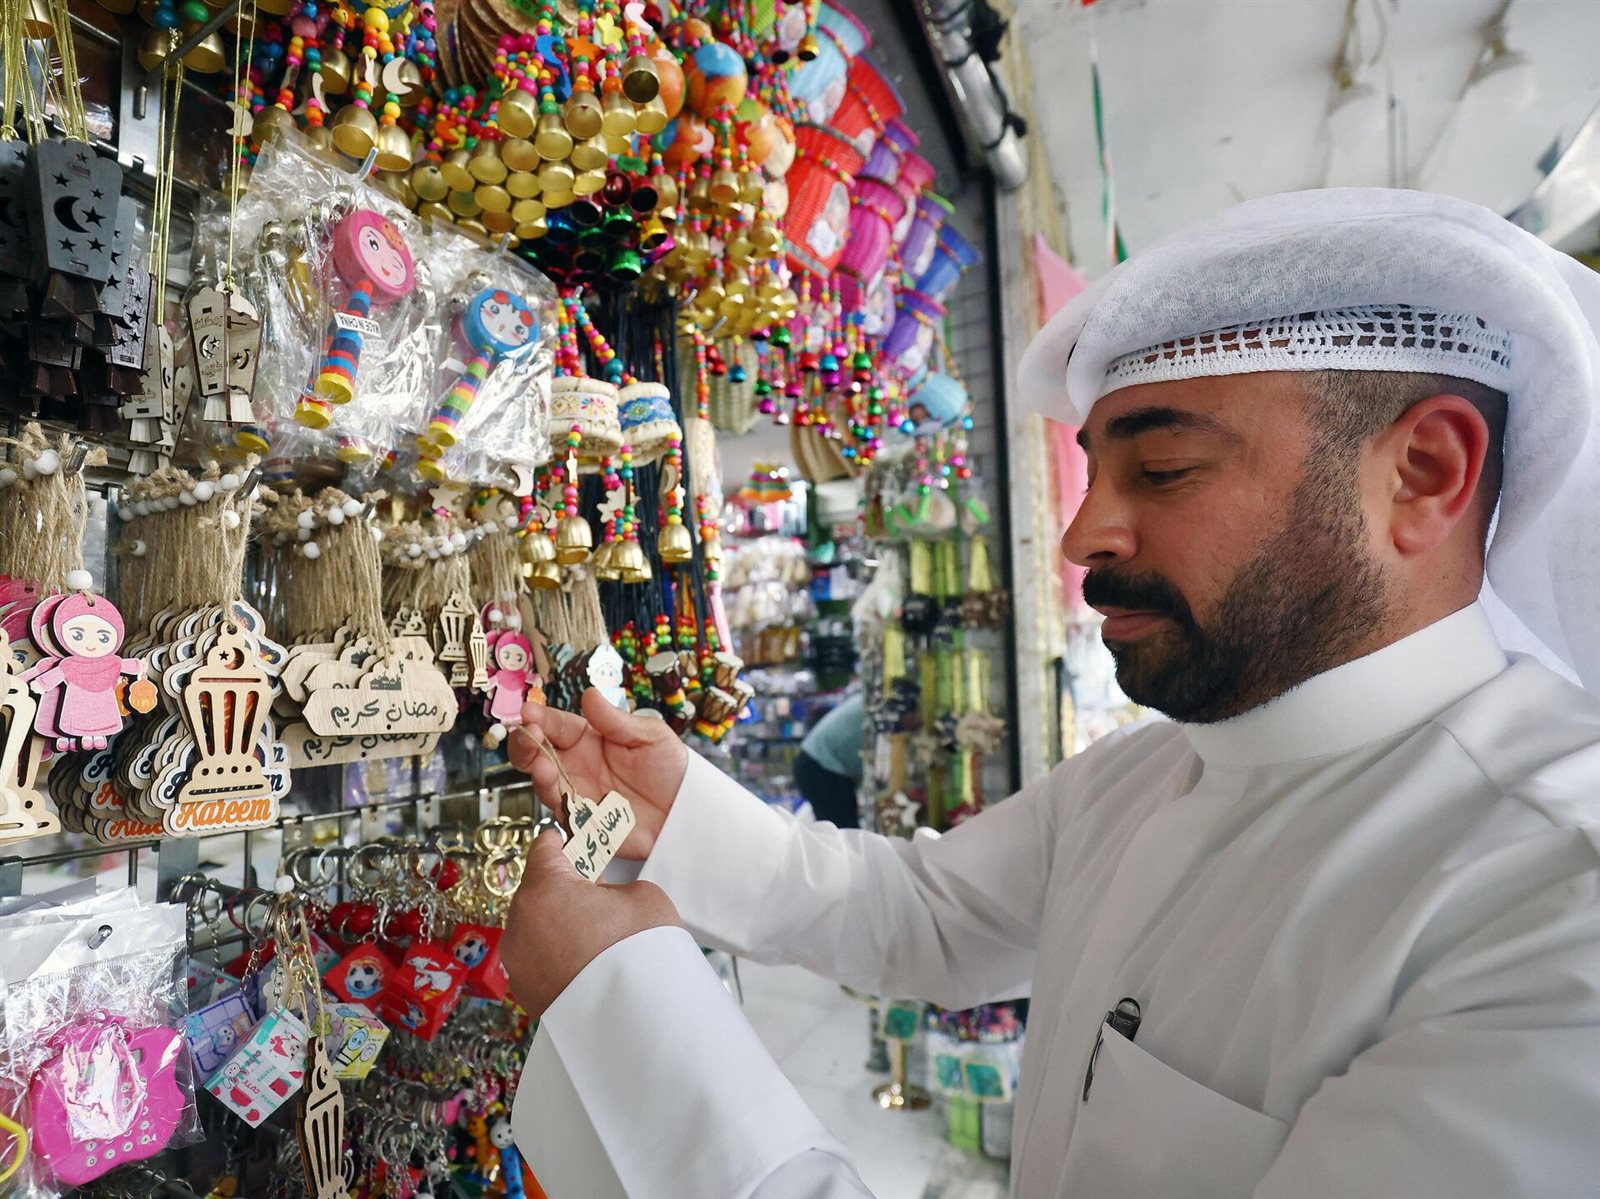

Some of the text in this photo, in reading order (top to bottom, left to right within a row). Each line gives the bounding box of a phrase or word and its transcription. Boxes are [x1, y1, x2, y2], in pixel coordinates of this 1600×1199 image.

[330, 699, 447, 729] رمضان كريم
[176, 798, 271, 829] Kareem
[574, 807, 630, 879] رمضان كريم
[243, 1080, 261, 1095] CUTE
